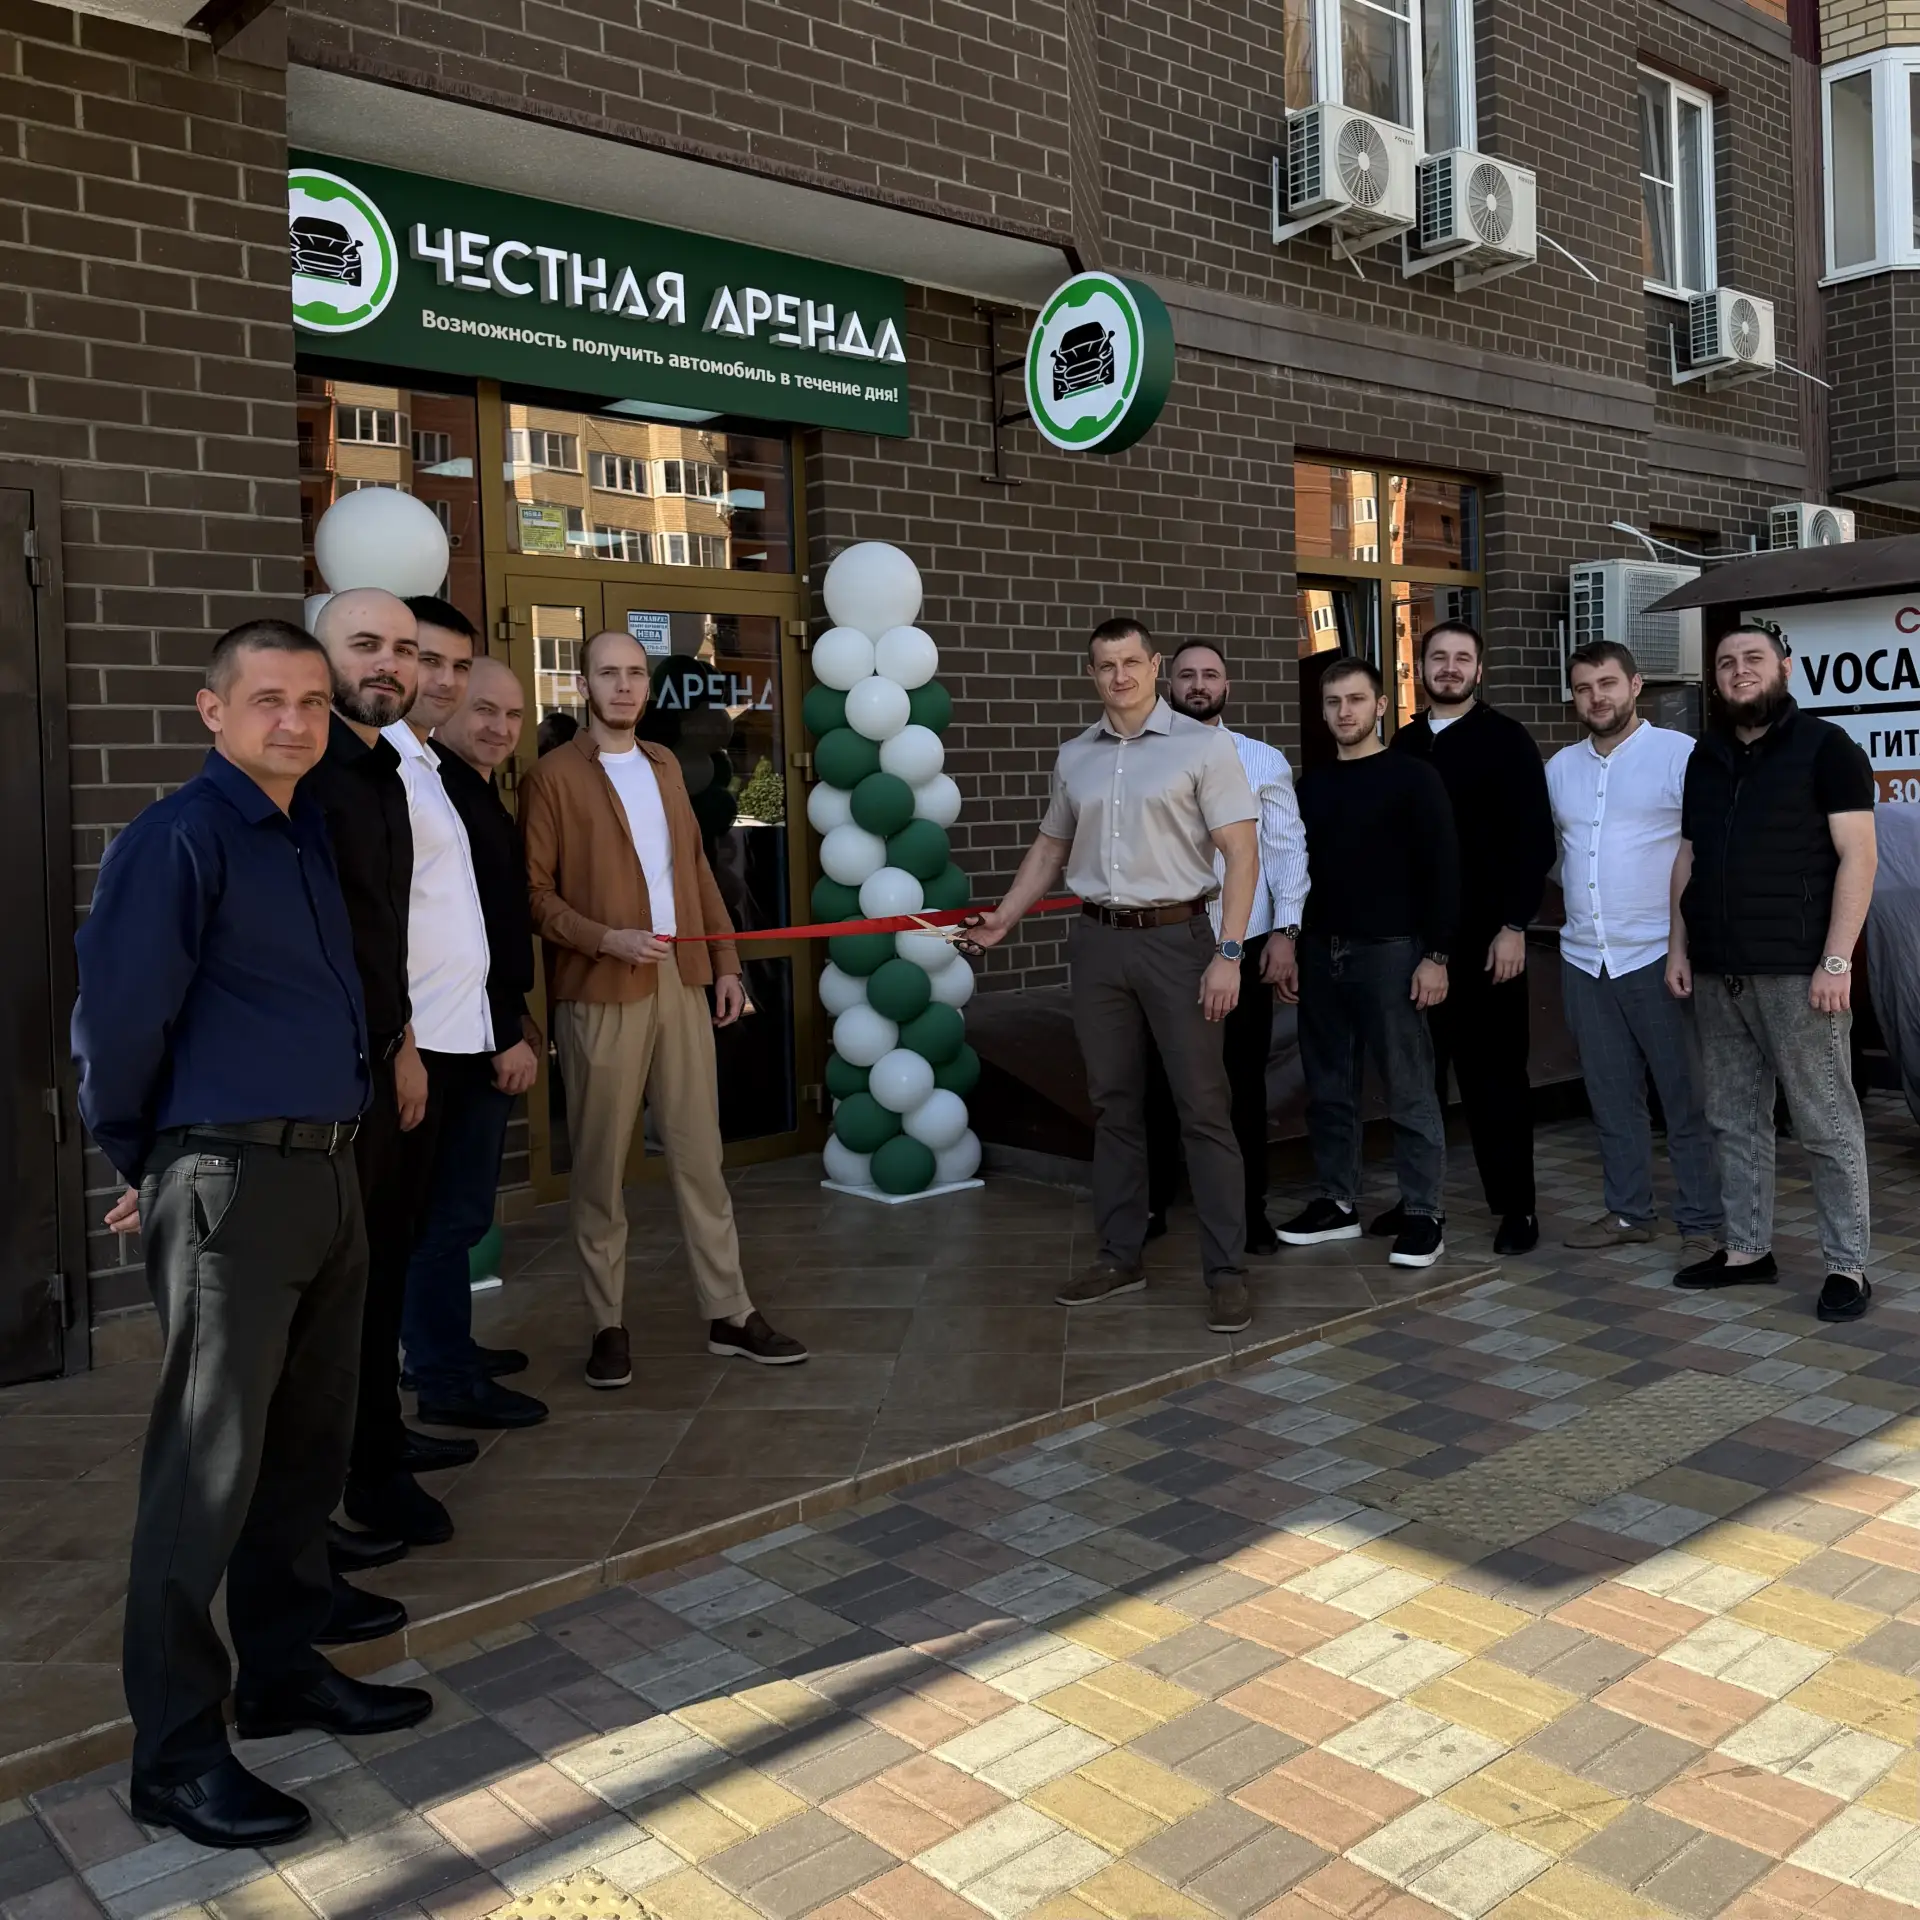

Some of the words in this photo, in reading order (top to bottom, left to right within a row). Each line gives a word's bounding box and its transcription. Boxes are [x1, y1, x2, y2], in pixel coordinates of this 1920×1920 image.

[410, 222, 686, 327] ЧЕСТНАЯ
[702, 284, 907, 365] АРЕНДА
[421, 308, 568, 350] Возможность
[572, 337, 665, 365] получить
[668, 352, 777, 383] автомобиль
[780, 372, 791, 386] в
[794, 373, 862, 397] течение
[864, 385, 900, 403] дня!
[1870, 729, 1920, 758] ГИТ
